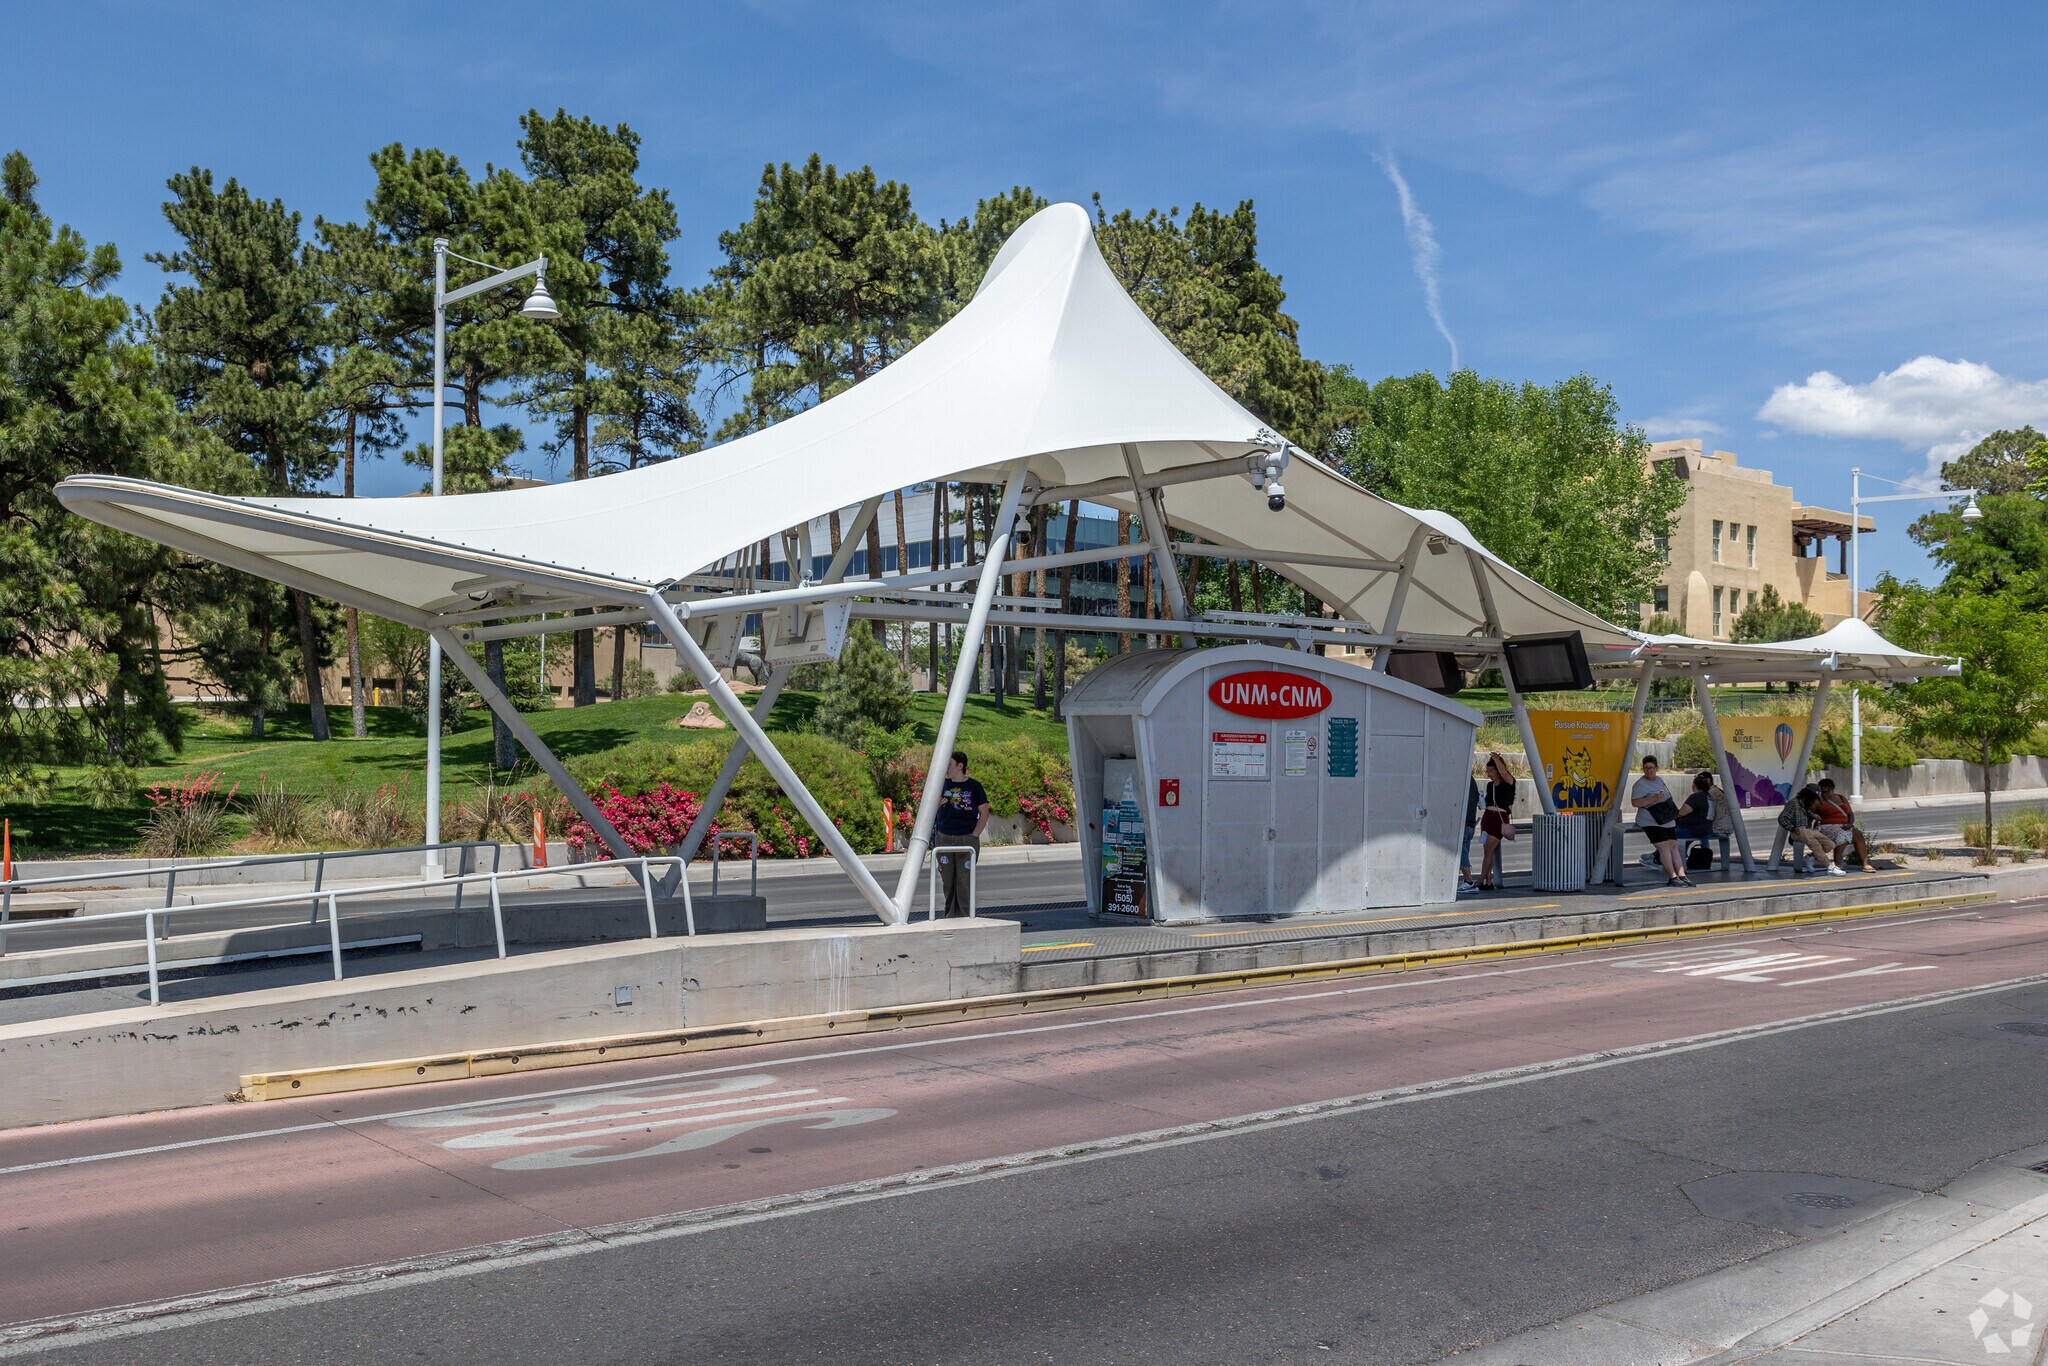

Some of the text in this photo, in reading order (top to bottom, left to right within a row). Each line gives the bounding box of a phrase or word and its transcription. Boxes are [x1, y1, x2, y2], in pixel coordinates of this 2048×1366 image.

[1554, 720, 1610, 732] Pursue Knowledge
[1735, 728, 1744, 736] ONE
[1552, 781, 1602, 809] CNM
[1115, 892, 1133, 903] (505)
[1107, 903, 1140, 913] 391-2600
